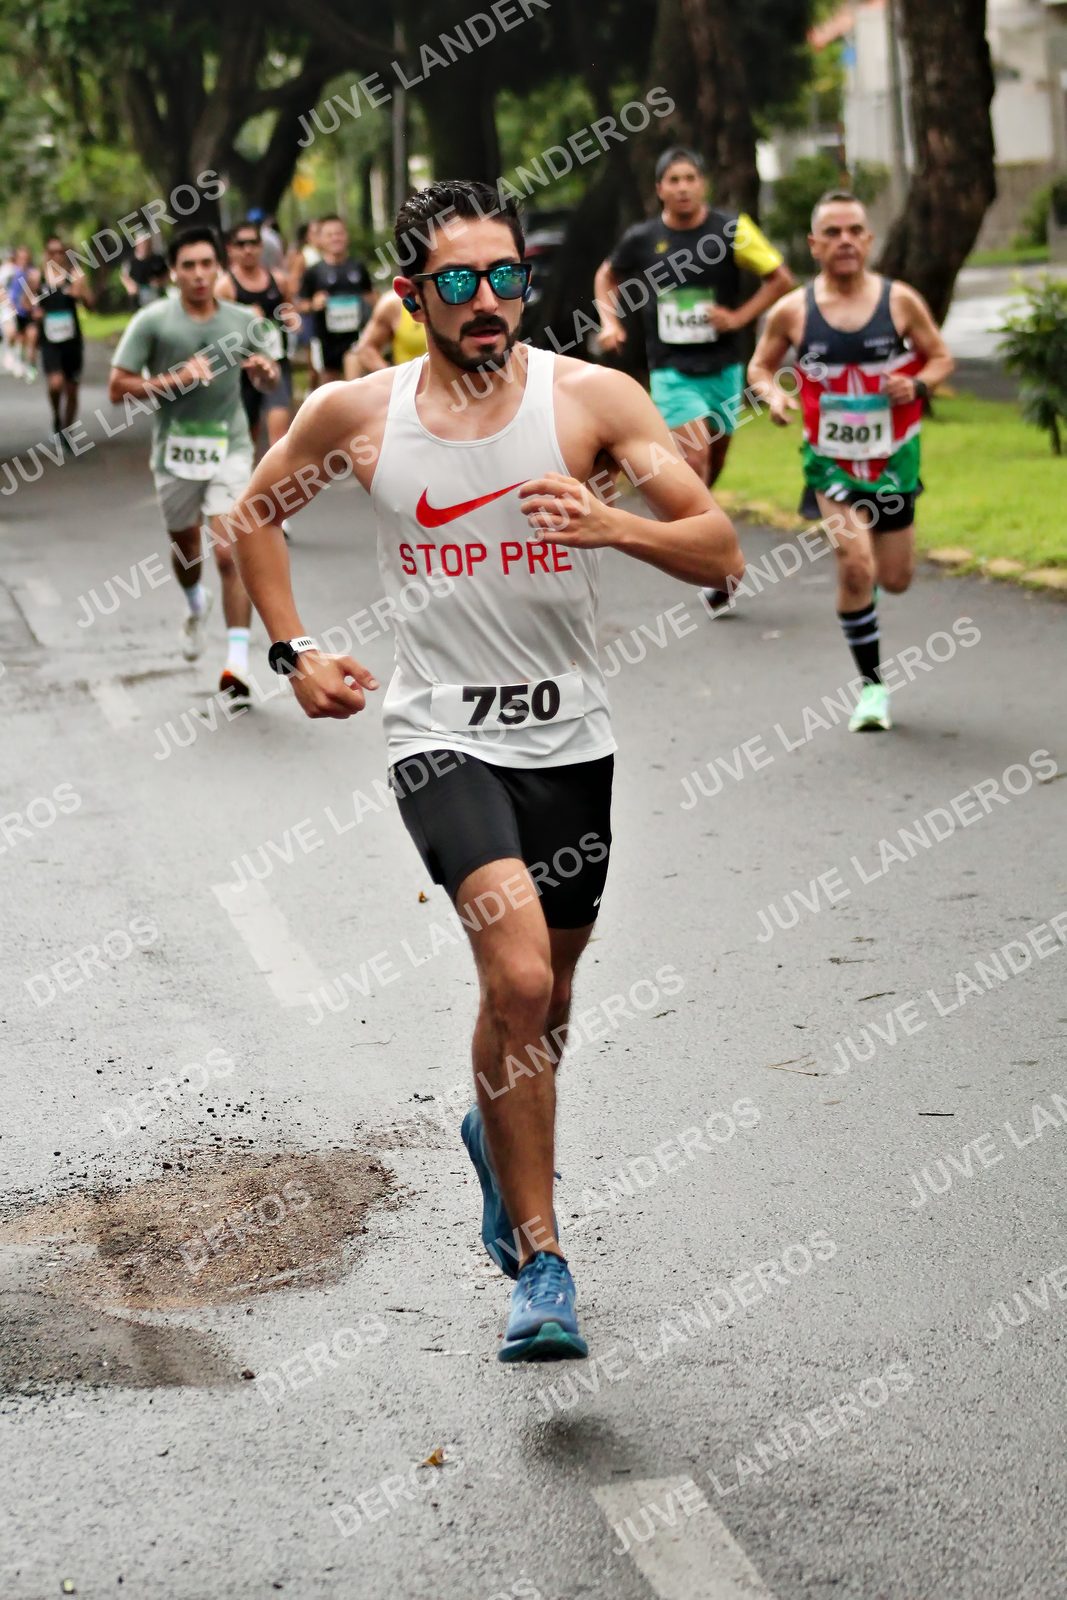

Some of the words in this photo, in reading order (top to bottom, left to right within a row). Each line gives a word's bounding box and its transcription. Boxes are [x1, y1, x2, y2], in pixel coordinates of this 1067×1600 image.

[826, 422, 882, 443] 2801
[171, 446, 221, 465] 2034
[399, 543, 487, 577] STOP
[501, 541, 572, 576] PRE
[462, 680, 561, 726] 750
